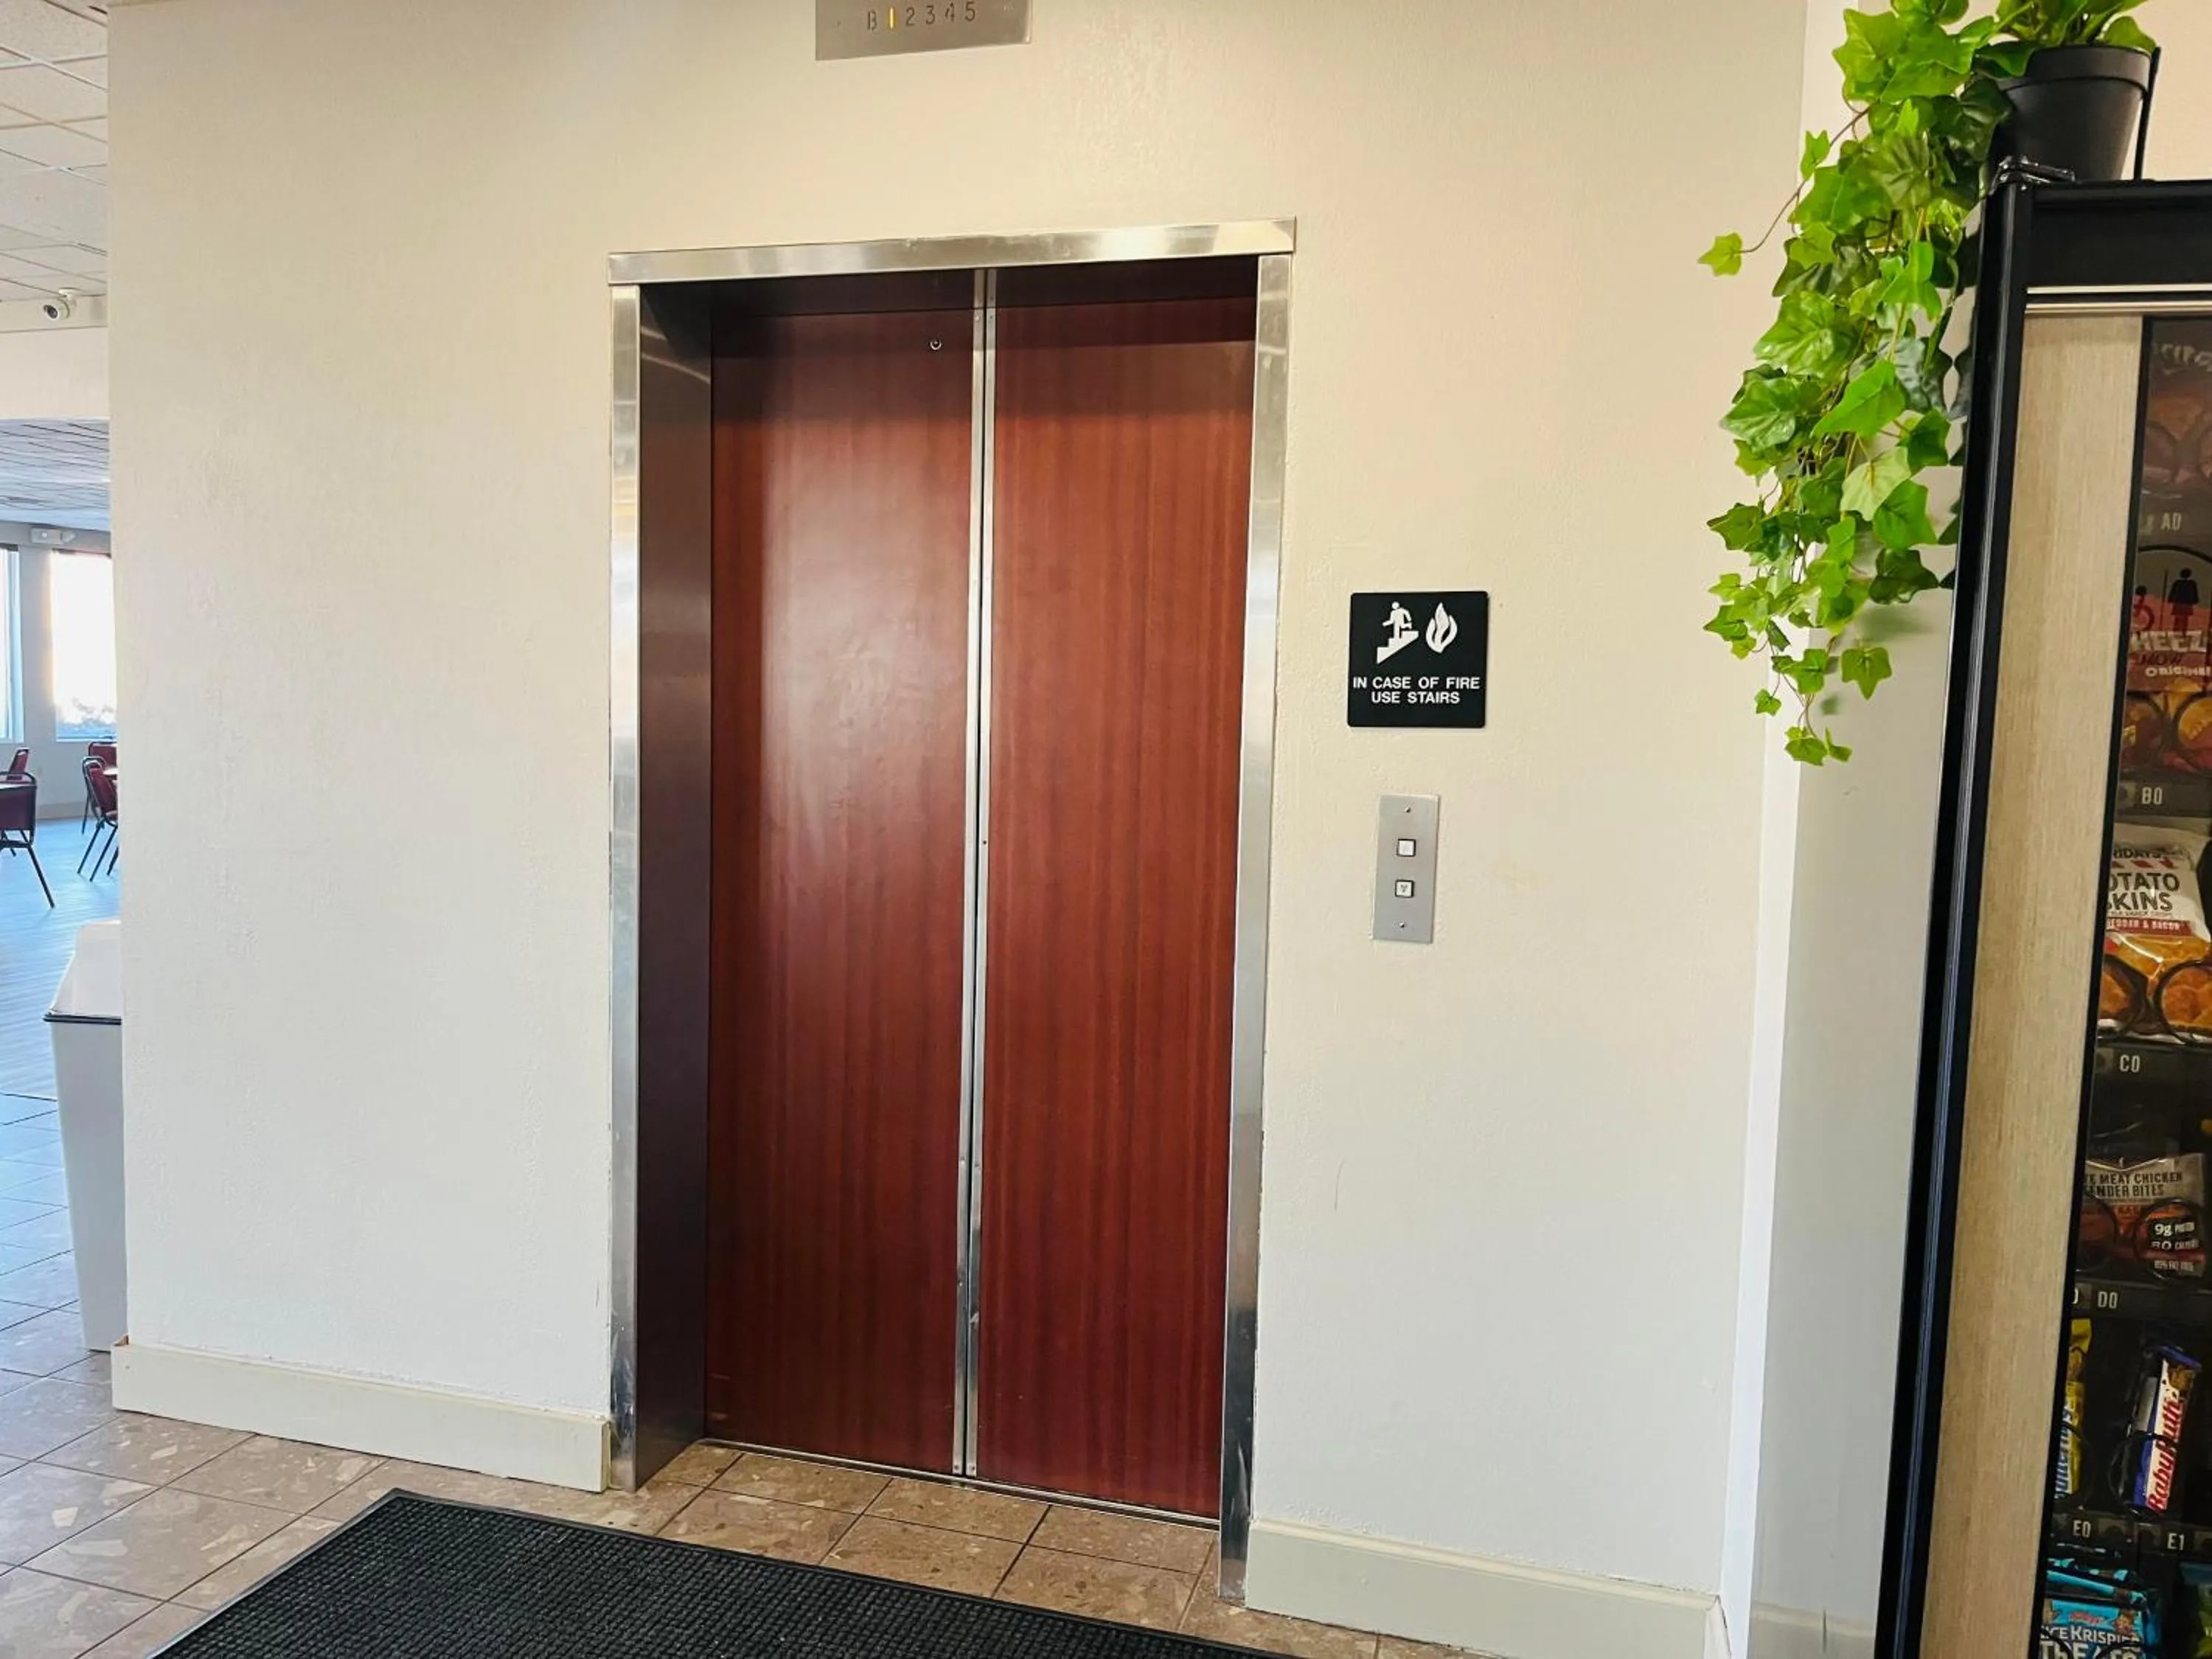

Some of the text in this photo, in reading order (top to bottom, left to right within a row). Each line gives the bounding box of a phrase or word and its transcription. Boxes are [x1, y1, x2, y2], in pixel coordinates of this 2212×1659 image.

[905, 7, 916, 27] 2
[925, 5, 936, 24] 3
[945, 2, 955, 22] 4
[964, 1, 975, 21] 5
[2130, 630, 2207, 653] HEEZ
[1353, 676, 1480, 689] IN CASE OF FIRE
[1371, 691, 1461, 704] USE STAIRS
[2099, 1172, 2131, 1185] MEAT
[2134, 1172, 2183, 1183] CHICKEN
[2073, 1520, 2091, 1538] E0
[2167, 1533, 2185, 1551] E1
